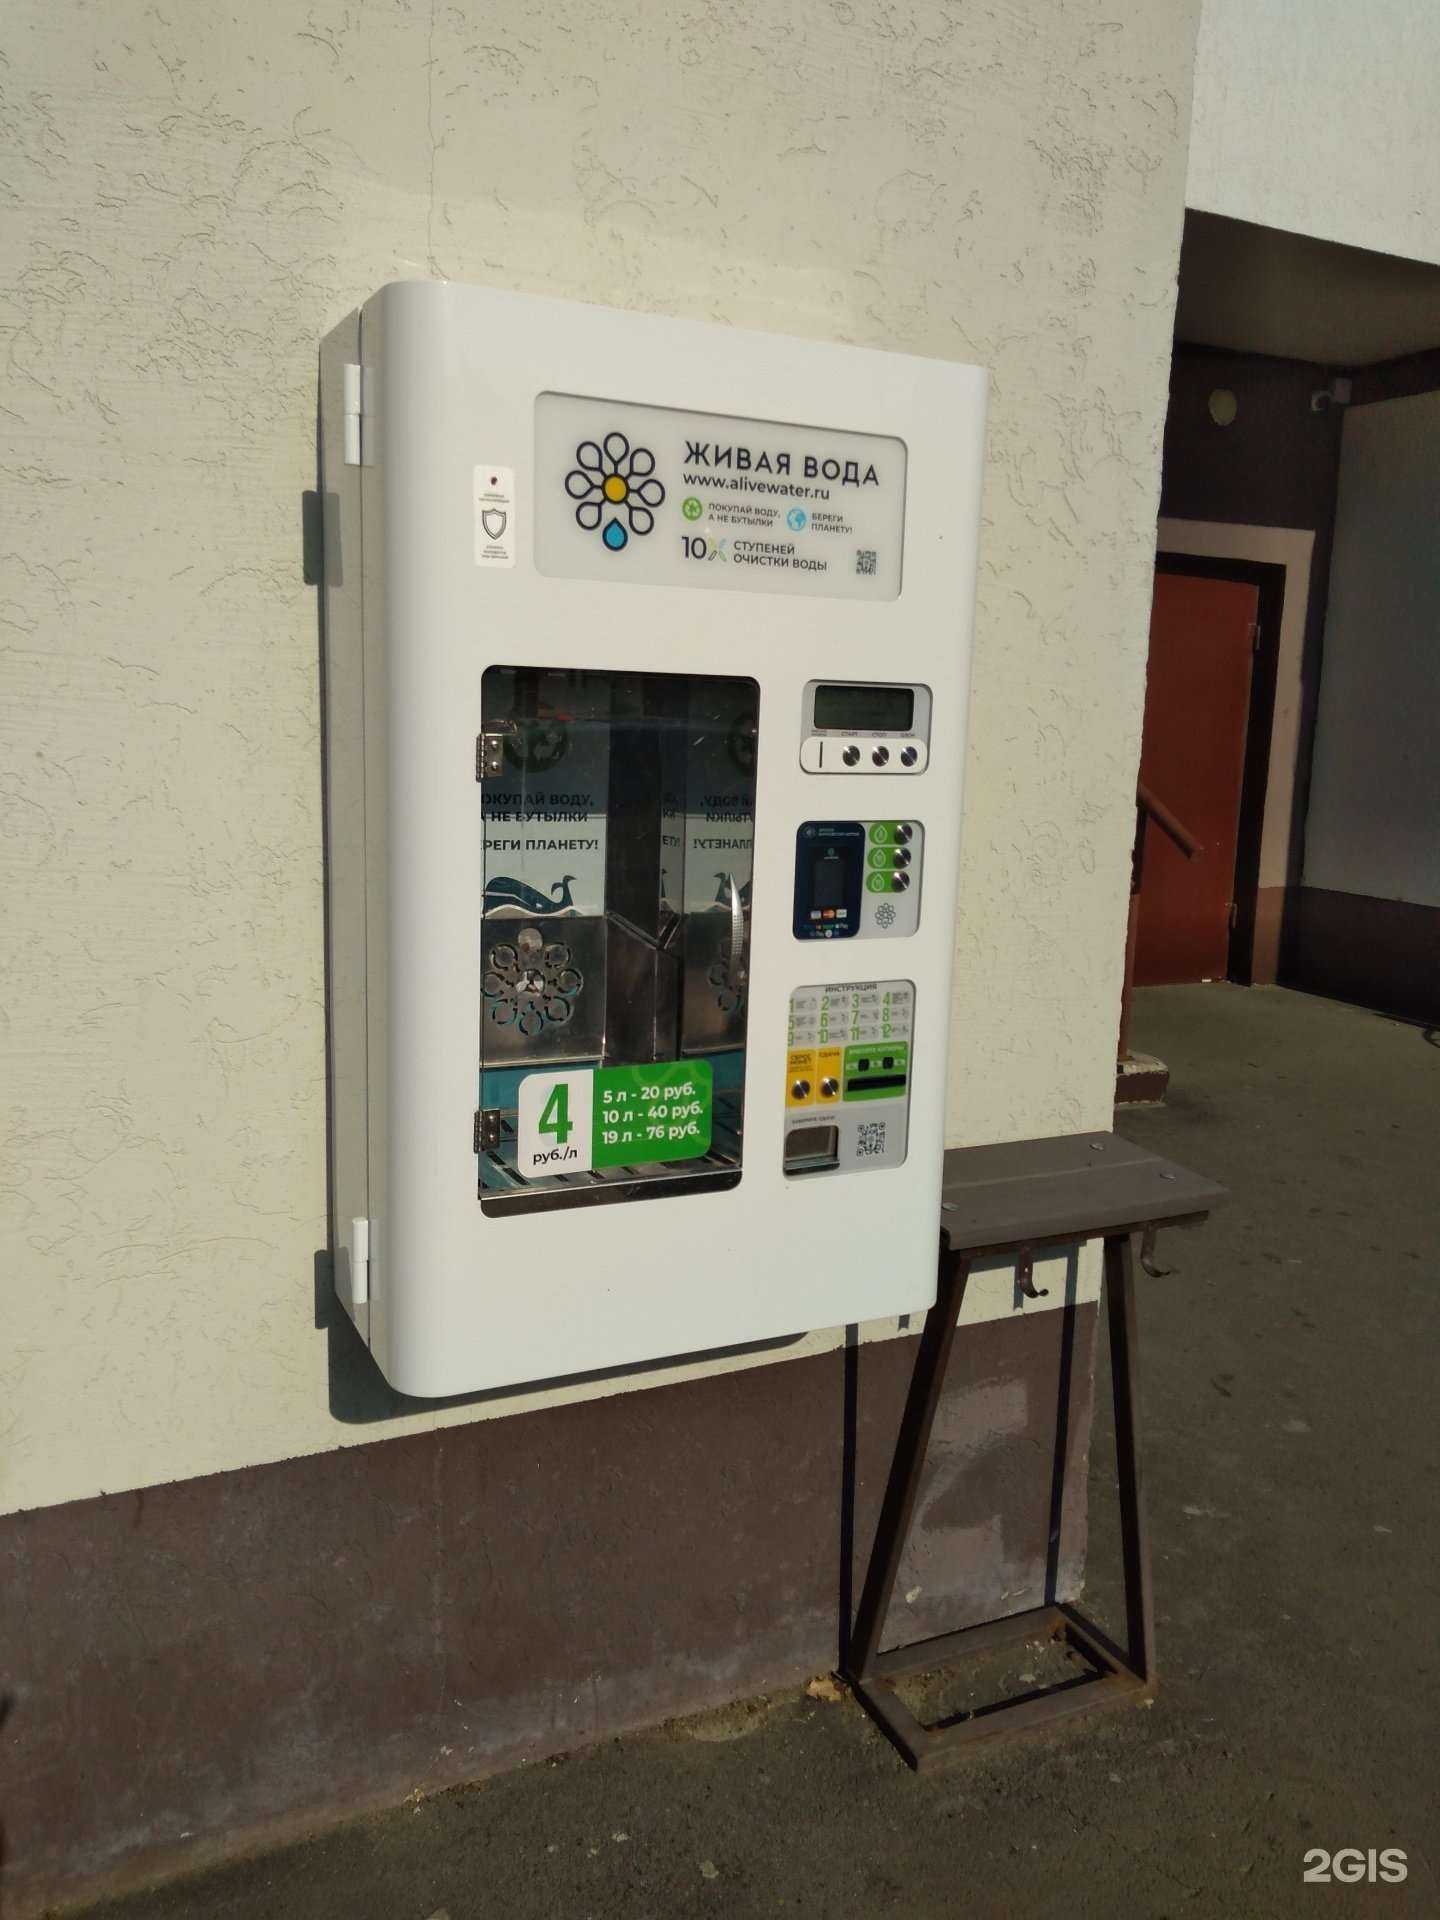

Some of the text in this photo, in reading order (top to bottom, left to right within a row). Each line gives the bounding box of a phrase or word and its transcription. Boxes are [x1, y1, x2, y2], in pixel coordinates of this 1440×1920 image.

[684, 441, 880, 488] ЖИВАЯ ВОДА
[683, 472, 830, 500] www.alivewater.ru
[708, 503, 780, 519] ПОКУПАЙ ВОДУ,
[812, 512, 844, 523] БЕРЕГИ
[717, 515, 729, 523] НЕ
[731, 516, 774, 527] БУТЫЛКИ
[811, 523, 853, 534] ПЛАНЕТУ!
[681, 536, 707, 560] 10
[734, 540, 795, 555] СТУПЕНЕЙ
[733, 554, 827, 571] ОЧИСТКИ ВОДЫ
[492, 811, 511, 822] НЕ
[526, 839, 599, 850] ПЛАНЕТУ!
[821, 996, 829, 1011] 2
[852, 993, 860, 1008] 3
[882, 992, 891, 1005] 4
[821, 1012, 829, 1027] 6
[851, 1010, 860, 1025] 7
[603, 1090, 613, 1104] 5
[616, 1091, 627, 1102] л
[641, 1086, 660, 1100] 20
[664, 1081, 696, 1101] руб.
[538, 1083, 573, 1145] 4
[602, 1110, 619, 1124] 10
[623, 1111, 633, 1122] л
[648, 1105, 668, 1118] 40
[672, 1101, 703, 1120] руб.
[602, 1131, 618, 1144] 19
[622, 1131, 633, 1142] л
[646, 1125, 665, 1140] 76
[669, 1121, 700, 1140] руб.
[533, 1146, 577, 1165] руб./л
